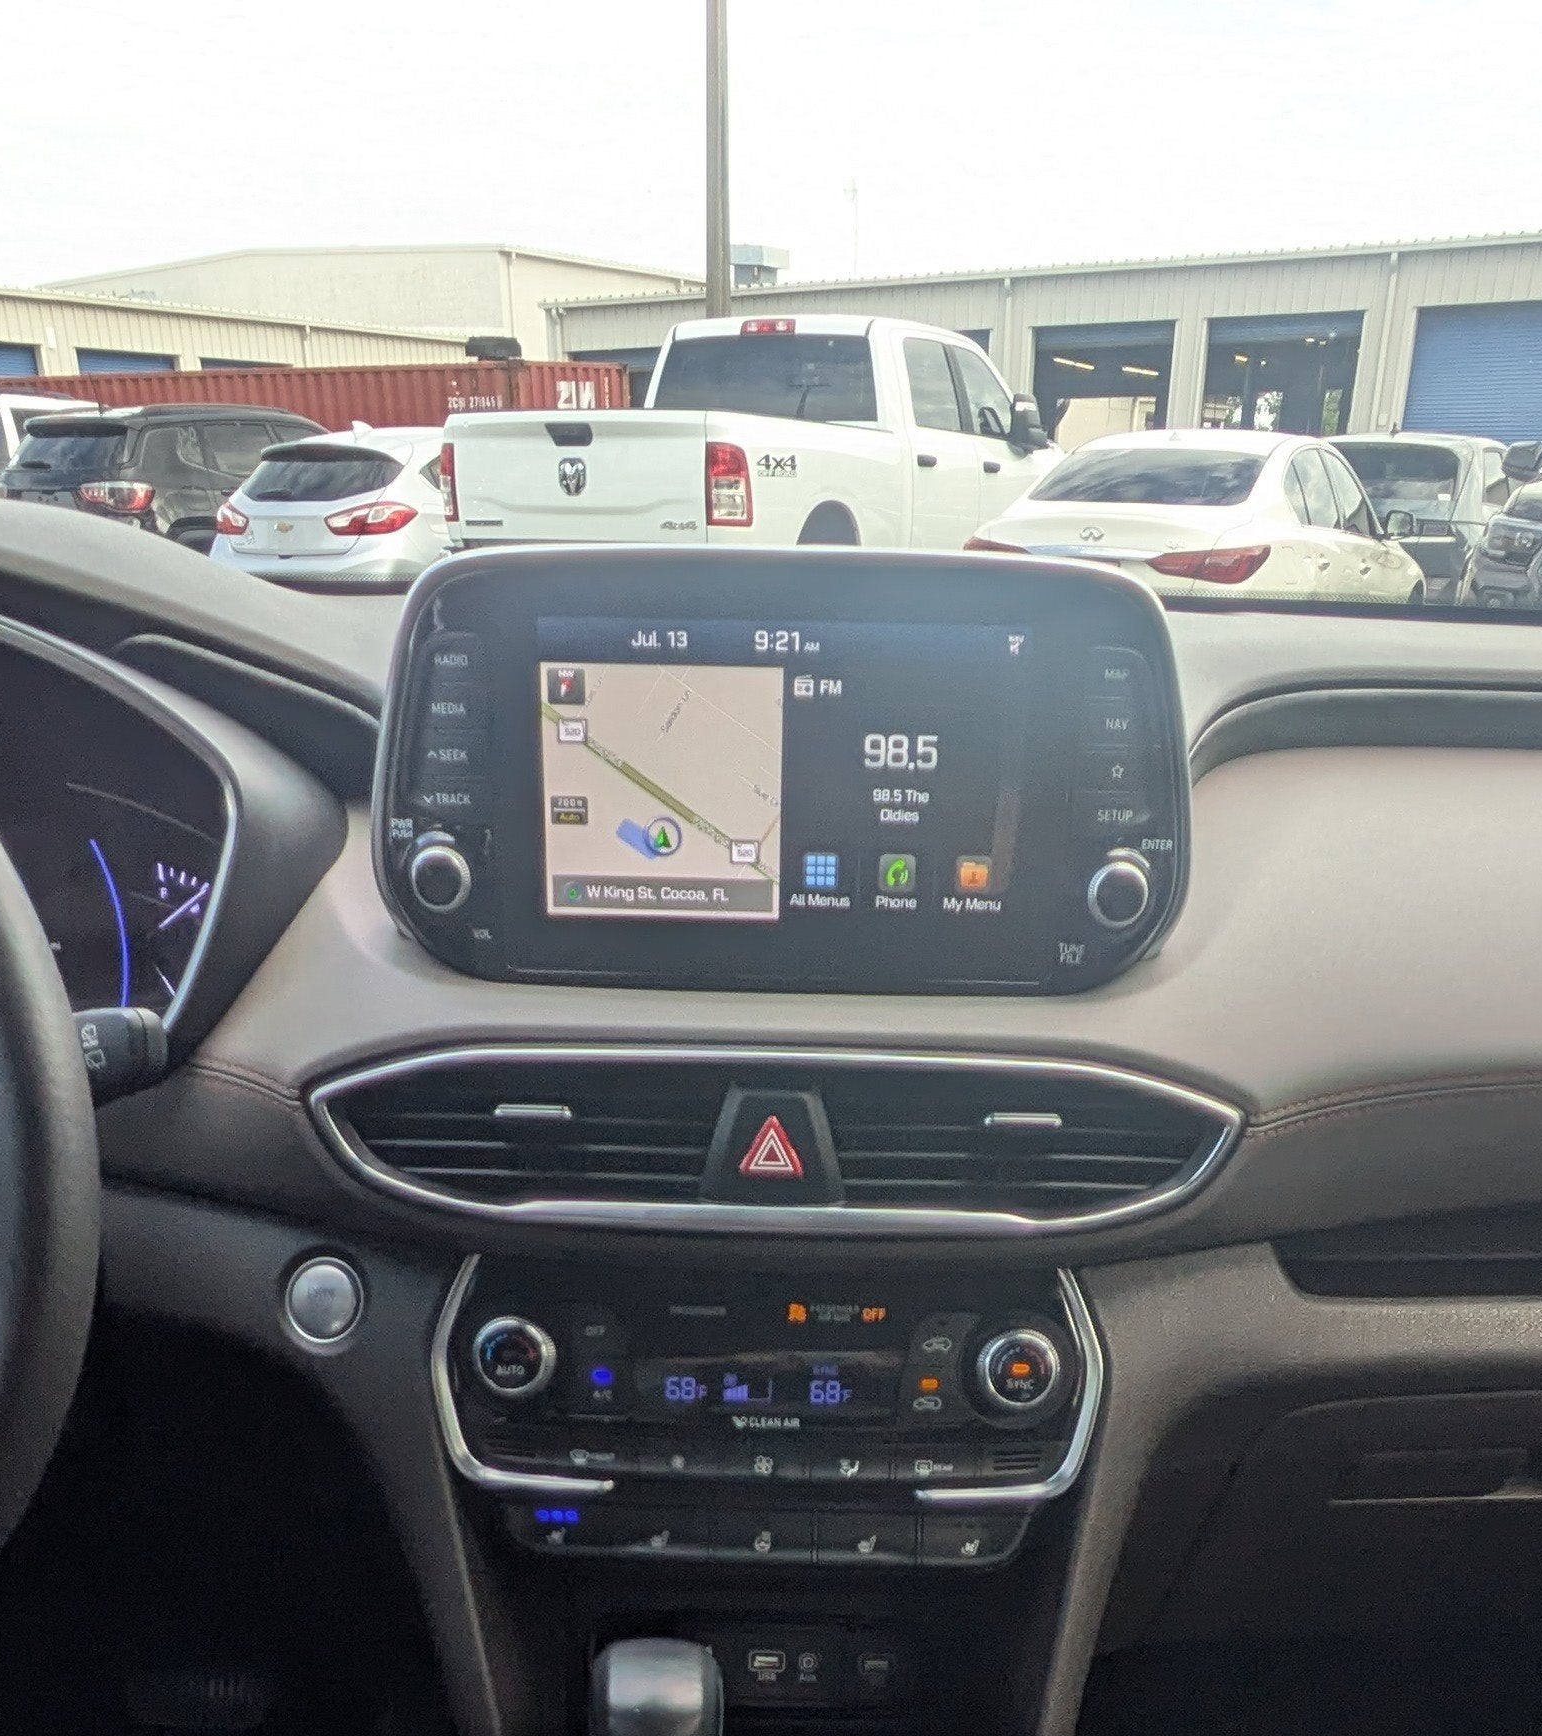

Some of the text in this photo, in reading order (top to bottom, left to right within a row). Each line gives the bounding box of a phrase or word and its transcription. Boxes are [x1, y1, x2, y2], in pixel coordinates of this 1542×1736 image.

[631, 630, 689, 648] Jul. 13
[754, 630, 820, 652] 9:21 AM
[434, 655, 468, 666] RADIO
[820, 679, 842, 695] FM
[431, 703, 466, 715] MEDIA
[1105, 718, 1130, 730] NAV
[440, 749, 467, 761] SEEK
[864, 733, 939, 770] 98.5
[436, 793, 471, 805] TRACK
[872, 788, 930, 804] 98.5 The
[879, 808, 920, 824] Oldies
[1097, 809, 1133, 822] SETUP
[1142, 838, 1173, 851] ENTER
[586, 885, 601, 898] W
[603, 885, 634, 901] King
[660, 887, 709, 902] Cocoa,
[713, 888, 729, 902] FL
[790, 893, 850, 908] All Menus
[875, 894, 917, 909] Phone
[943, 897, 1002, 912] My Menu
[861, 1307, 887, 1323] OFF
[495, 1364, 526, 1377] AUTO
[749, 1416, 800, 1428] CLEAN AIR
